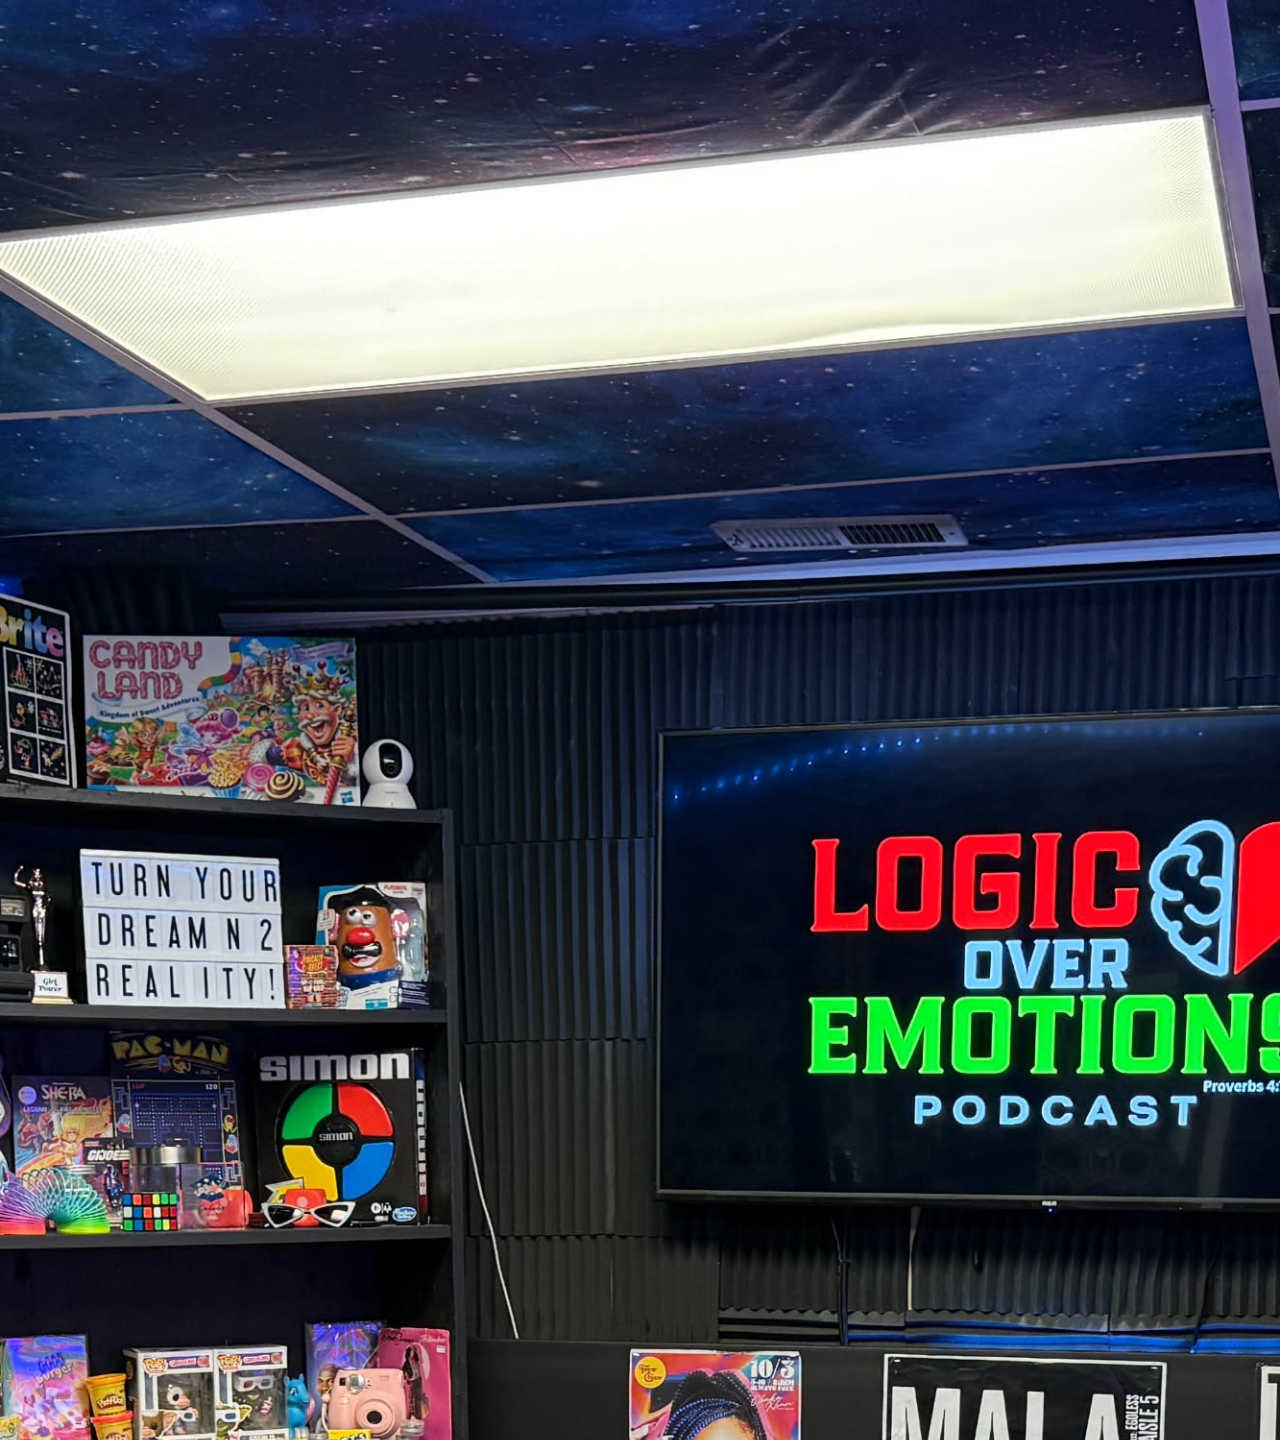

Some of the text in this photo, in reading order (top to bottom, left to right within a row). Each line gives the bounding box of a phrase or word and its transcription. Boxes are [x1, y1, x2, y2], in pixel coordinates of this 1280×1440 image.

[89, 640, 203, 670] CANDY
[97, 670, 184, 700] LAND
[90, 861, 278, 904] TURN YOUR
[811, 830, 1141, 932] LOGIC
[98, 912, 274, 952] DREAM N 2
[964, 937, 1130, 990] OVER
[111, 1034, 231, 1064] PAC-MAN
[259, 1053, 411, 1082] simon
[40, 1083, 87, 1101] SHE-RA
[1203, 1078, 1264, 1095] Proverbs
[914, 1095, 1198, 1127] PODCAST
[319, 1132, 354, 1142] simon
[751, 1358, 796, 1380] 10/3
[1125, 1393, 1140, 1431] EGOLESS
[1140, 1394, 1160, 1405] 5
